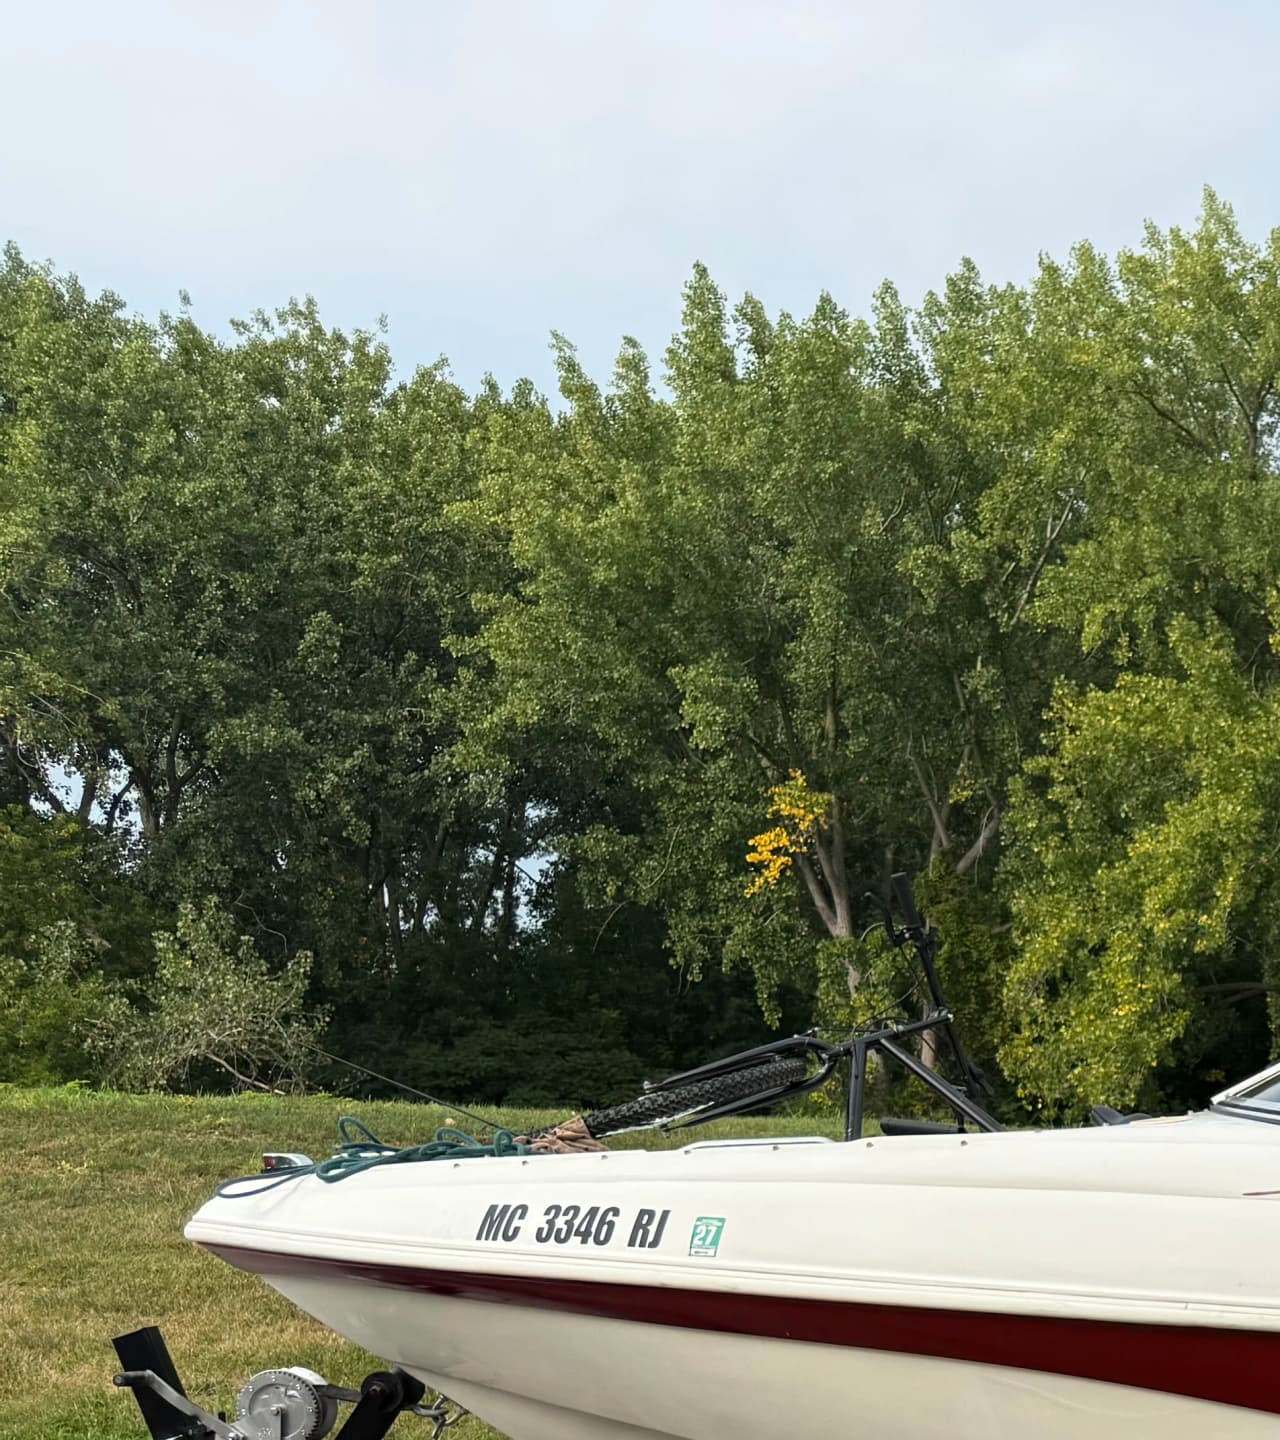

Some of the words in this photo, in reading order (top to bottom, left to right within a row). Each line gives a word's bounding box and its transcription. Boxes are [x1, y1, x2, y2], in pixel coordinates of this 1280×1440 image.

[475, 1204, 529, 1242] MC
[535, 1204, 621, 1247] 3346
[627, 1208, 671, 1249] RJ
[693, 1225, 717, 1246] 27
